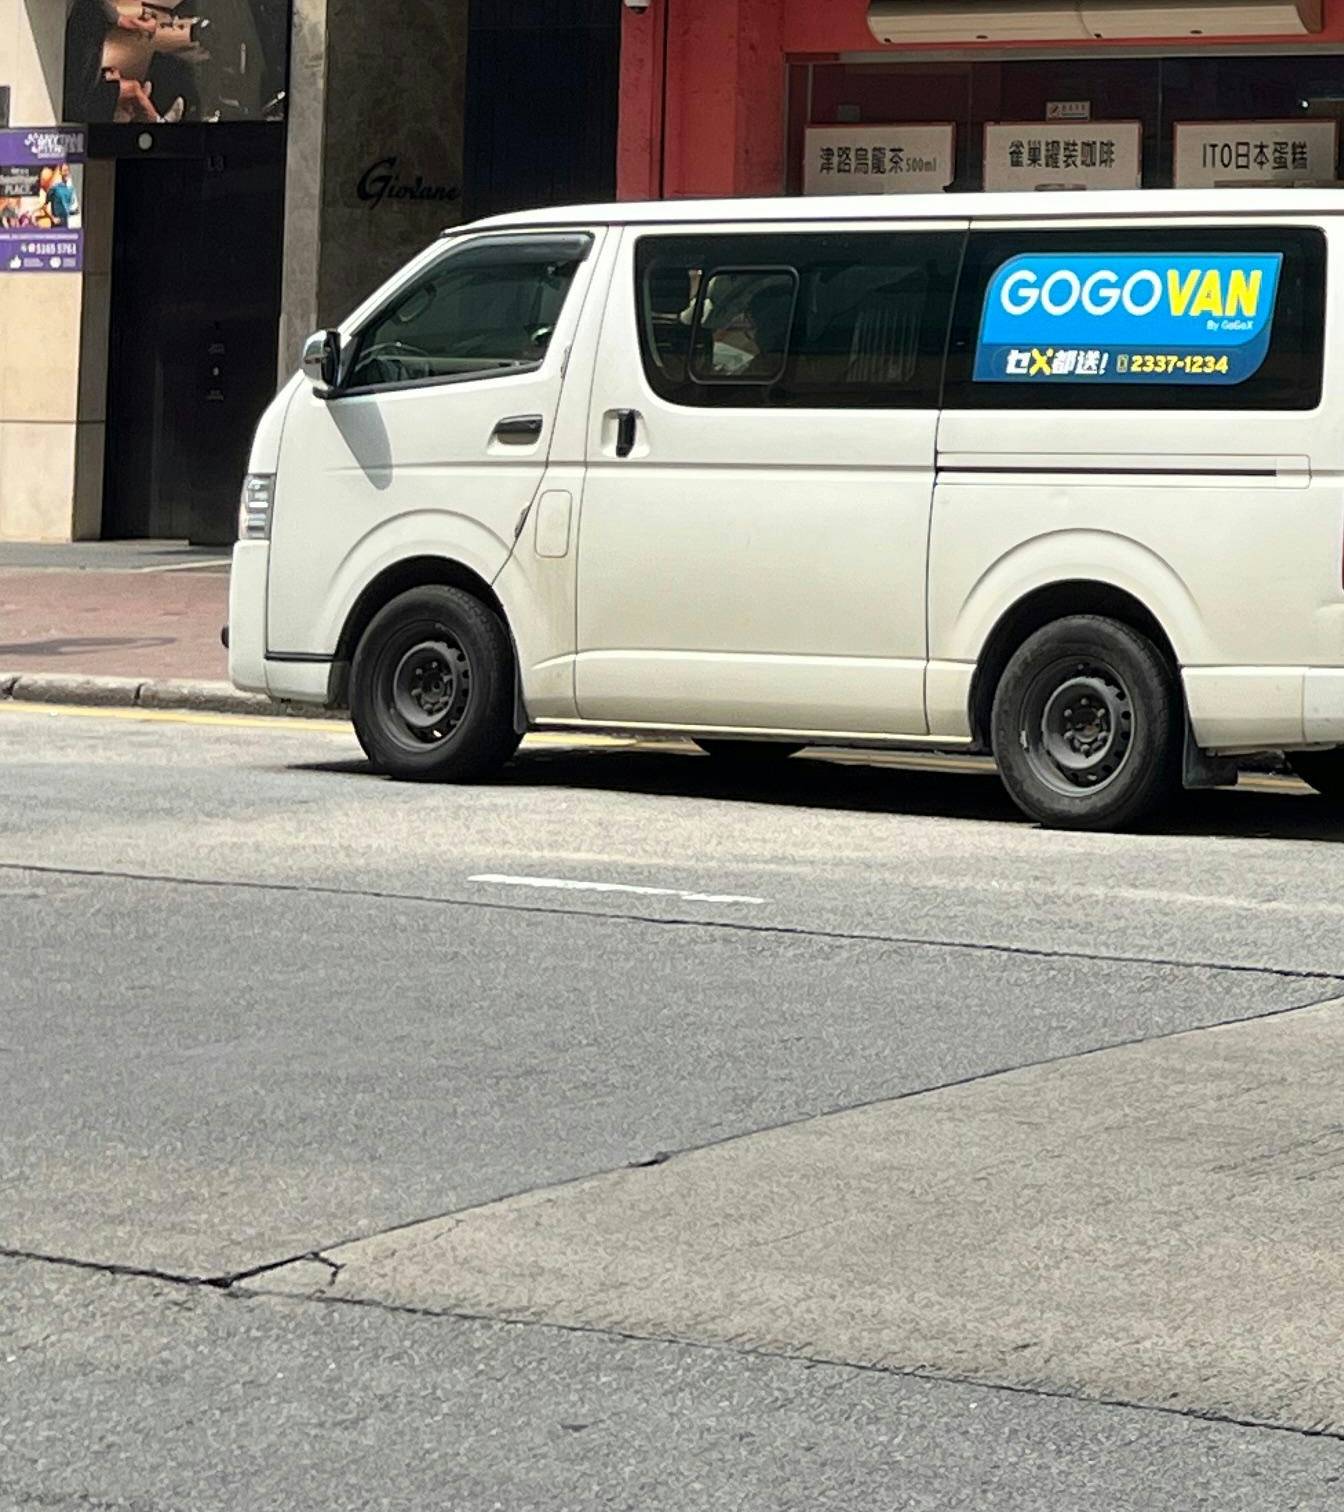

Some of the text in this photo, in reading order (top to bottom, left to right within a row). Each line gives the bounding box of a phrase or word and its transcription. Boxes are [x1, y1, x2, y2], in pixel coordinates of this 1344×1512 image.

[1009, 140, 1117, 170] 雀巢罐裝咖啡
[1201, 140, 1309, 172] ITO日本蛋糕
[1001, 269, 1263, 317] GOGOVAN
